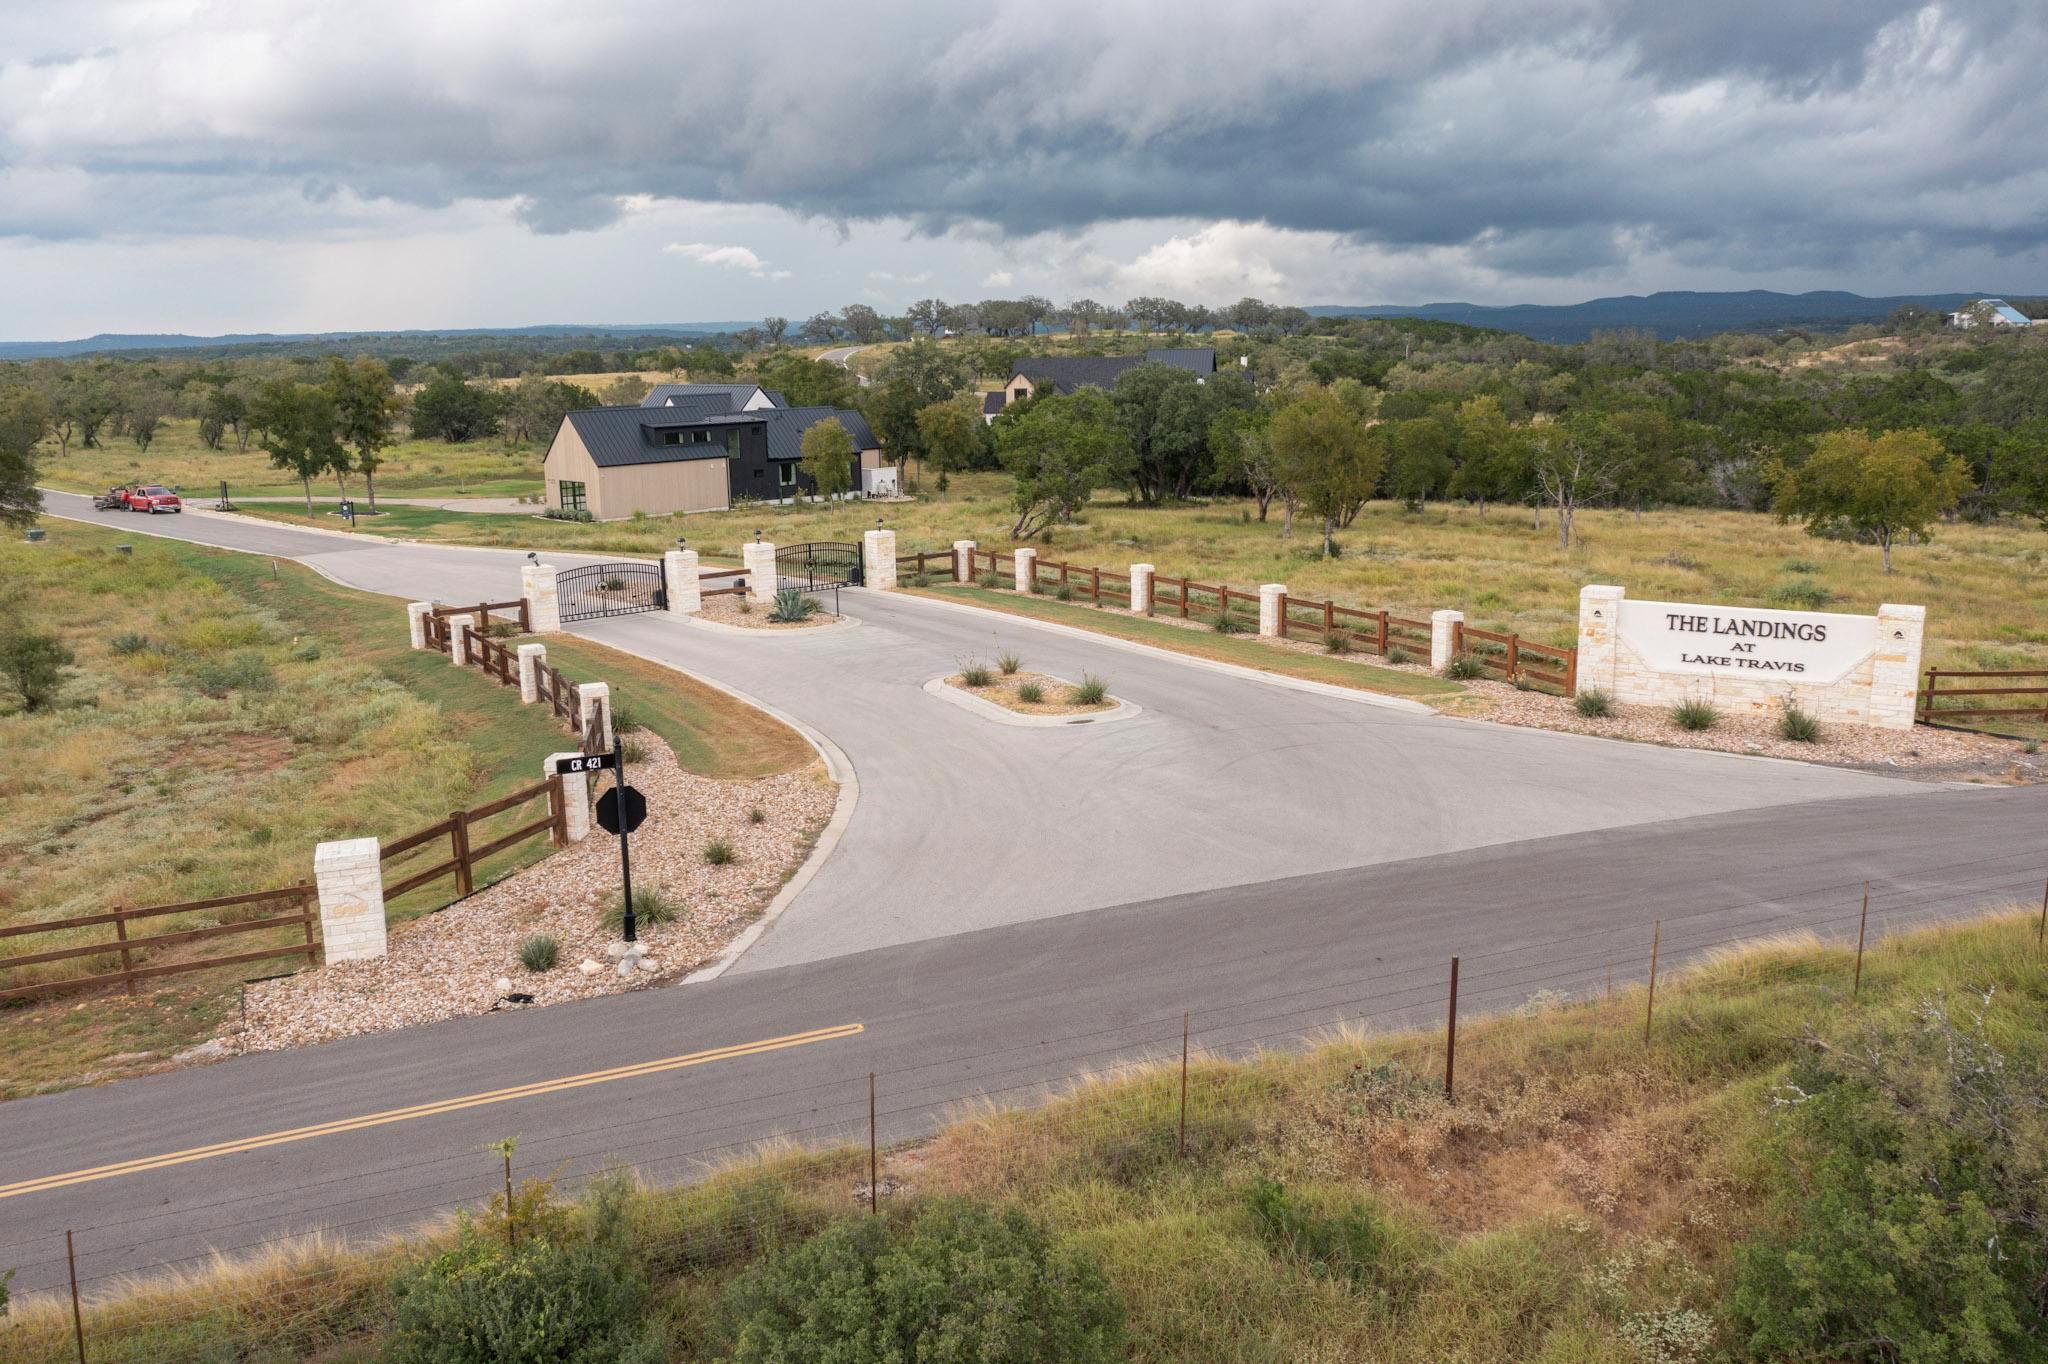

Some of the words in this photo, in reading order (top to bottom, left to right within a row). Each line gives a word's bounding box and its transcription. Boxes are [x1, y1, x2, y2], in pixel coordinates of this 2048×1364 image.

[1666, 614, 1708, 633] THE
[1712, 617, 1827, 642] LANDINGS
[1730, 643, 1756, 653] AT
[1681, 654, 1731, 667] LAKE
[1735, 658, 1805, 672] TRAVIS
[571, 760, 582, 771] CR
[586, 757, 602, 769] 421
